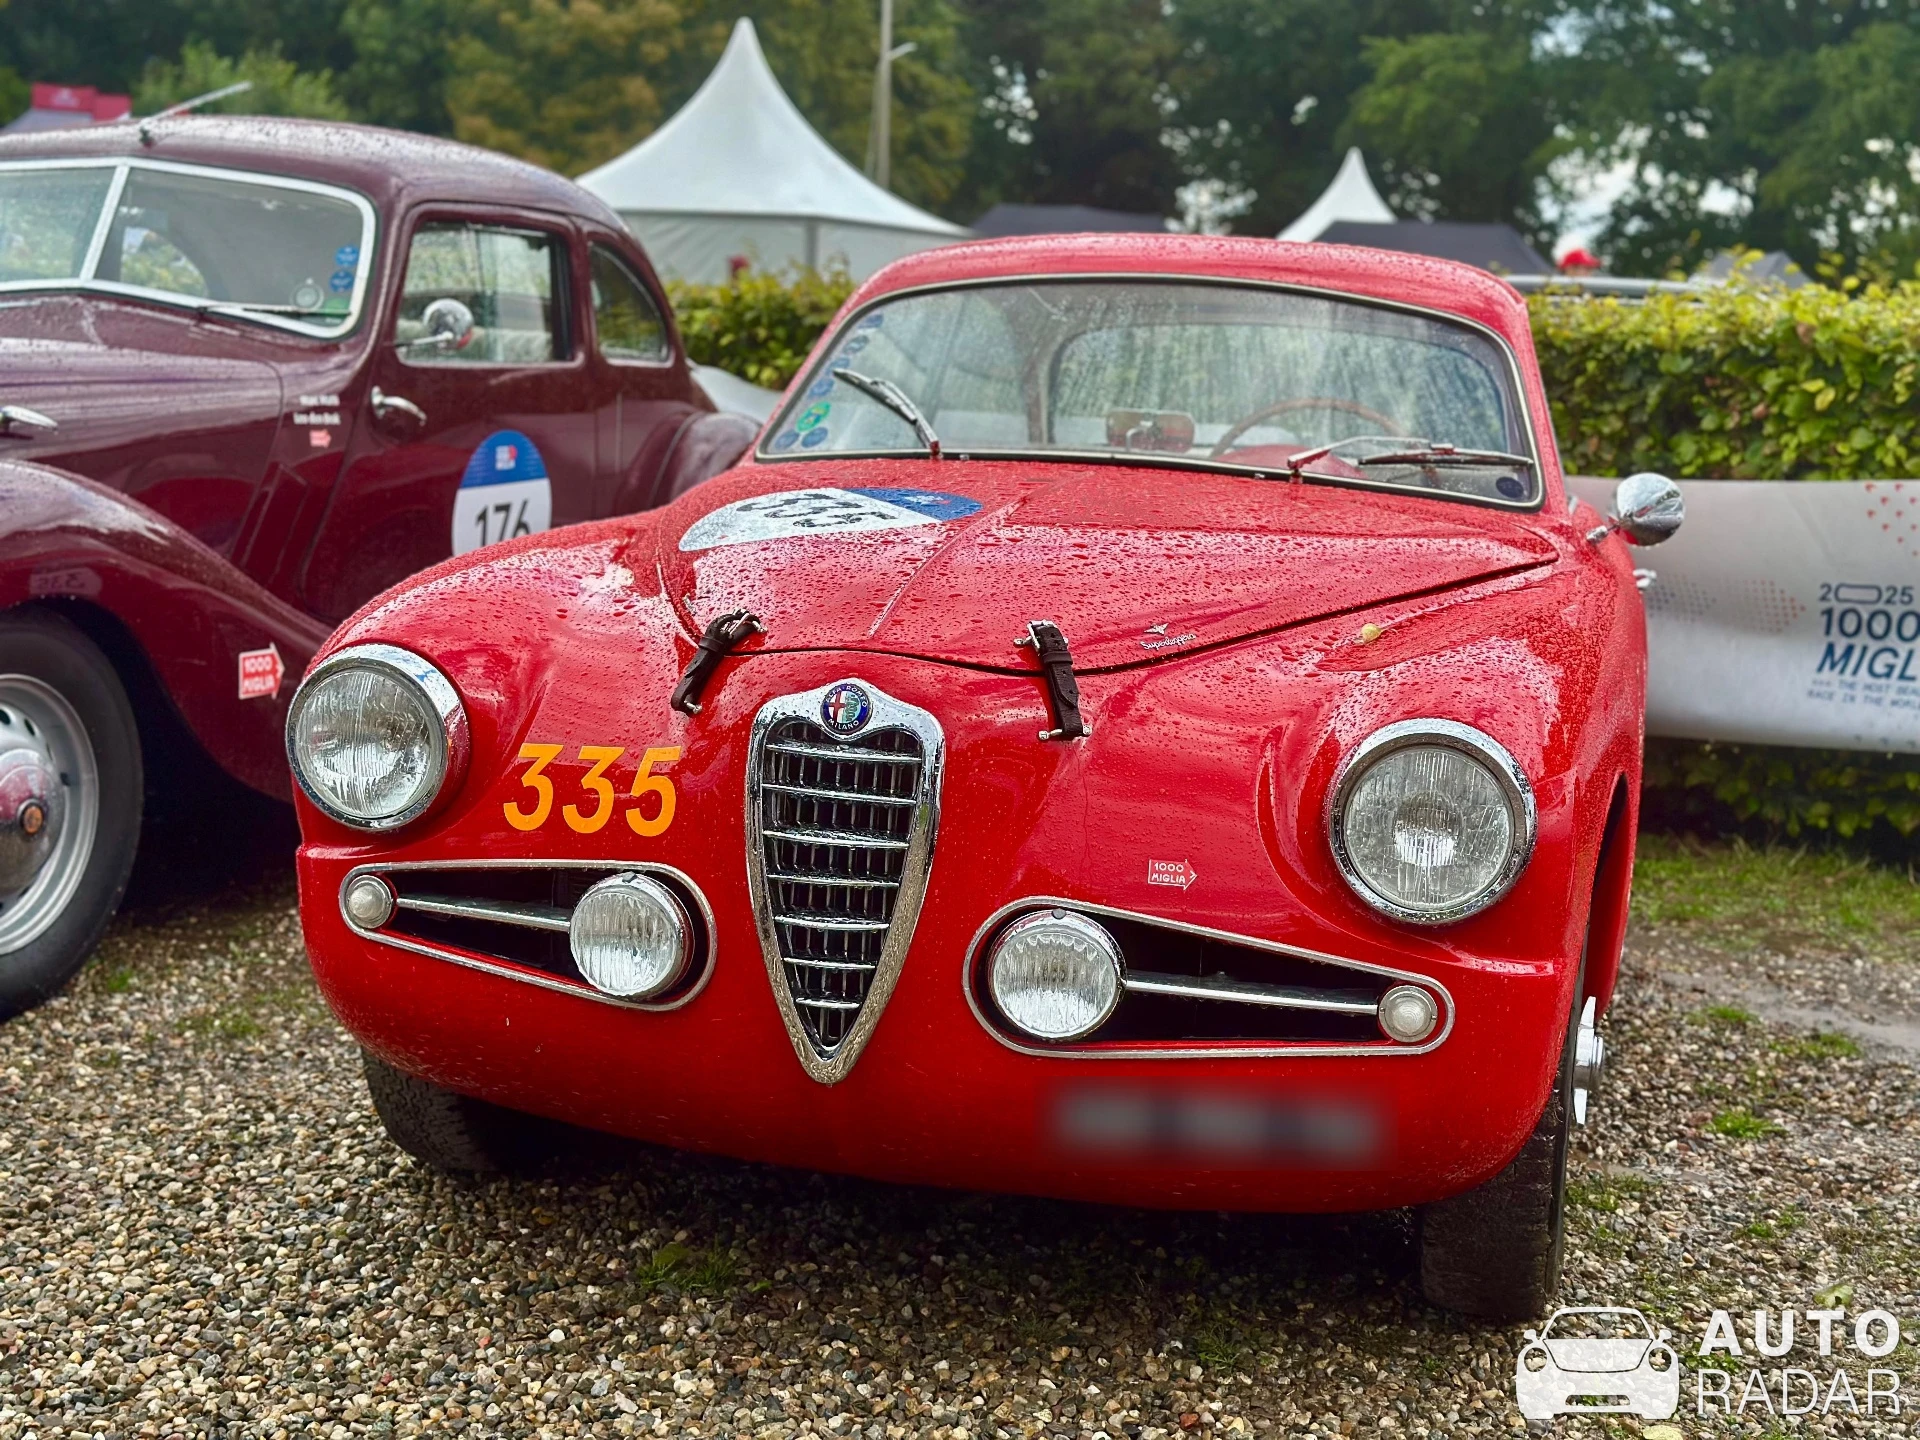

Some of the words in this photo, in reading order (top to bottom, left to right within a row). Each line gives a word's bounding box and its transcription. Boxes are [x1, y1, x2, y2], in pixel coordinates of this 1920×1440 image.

[1821, 607, 1920, 642] 1000
[244, 655, 273, 673] 1000
[243, 674, 275, 692] MIGLIA
[503, 742, 682, 837] 335
[1154, 861, 1184, 873] 1000
[1151, 872, 1186, 884] MIGLIA
